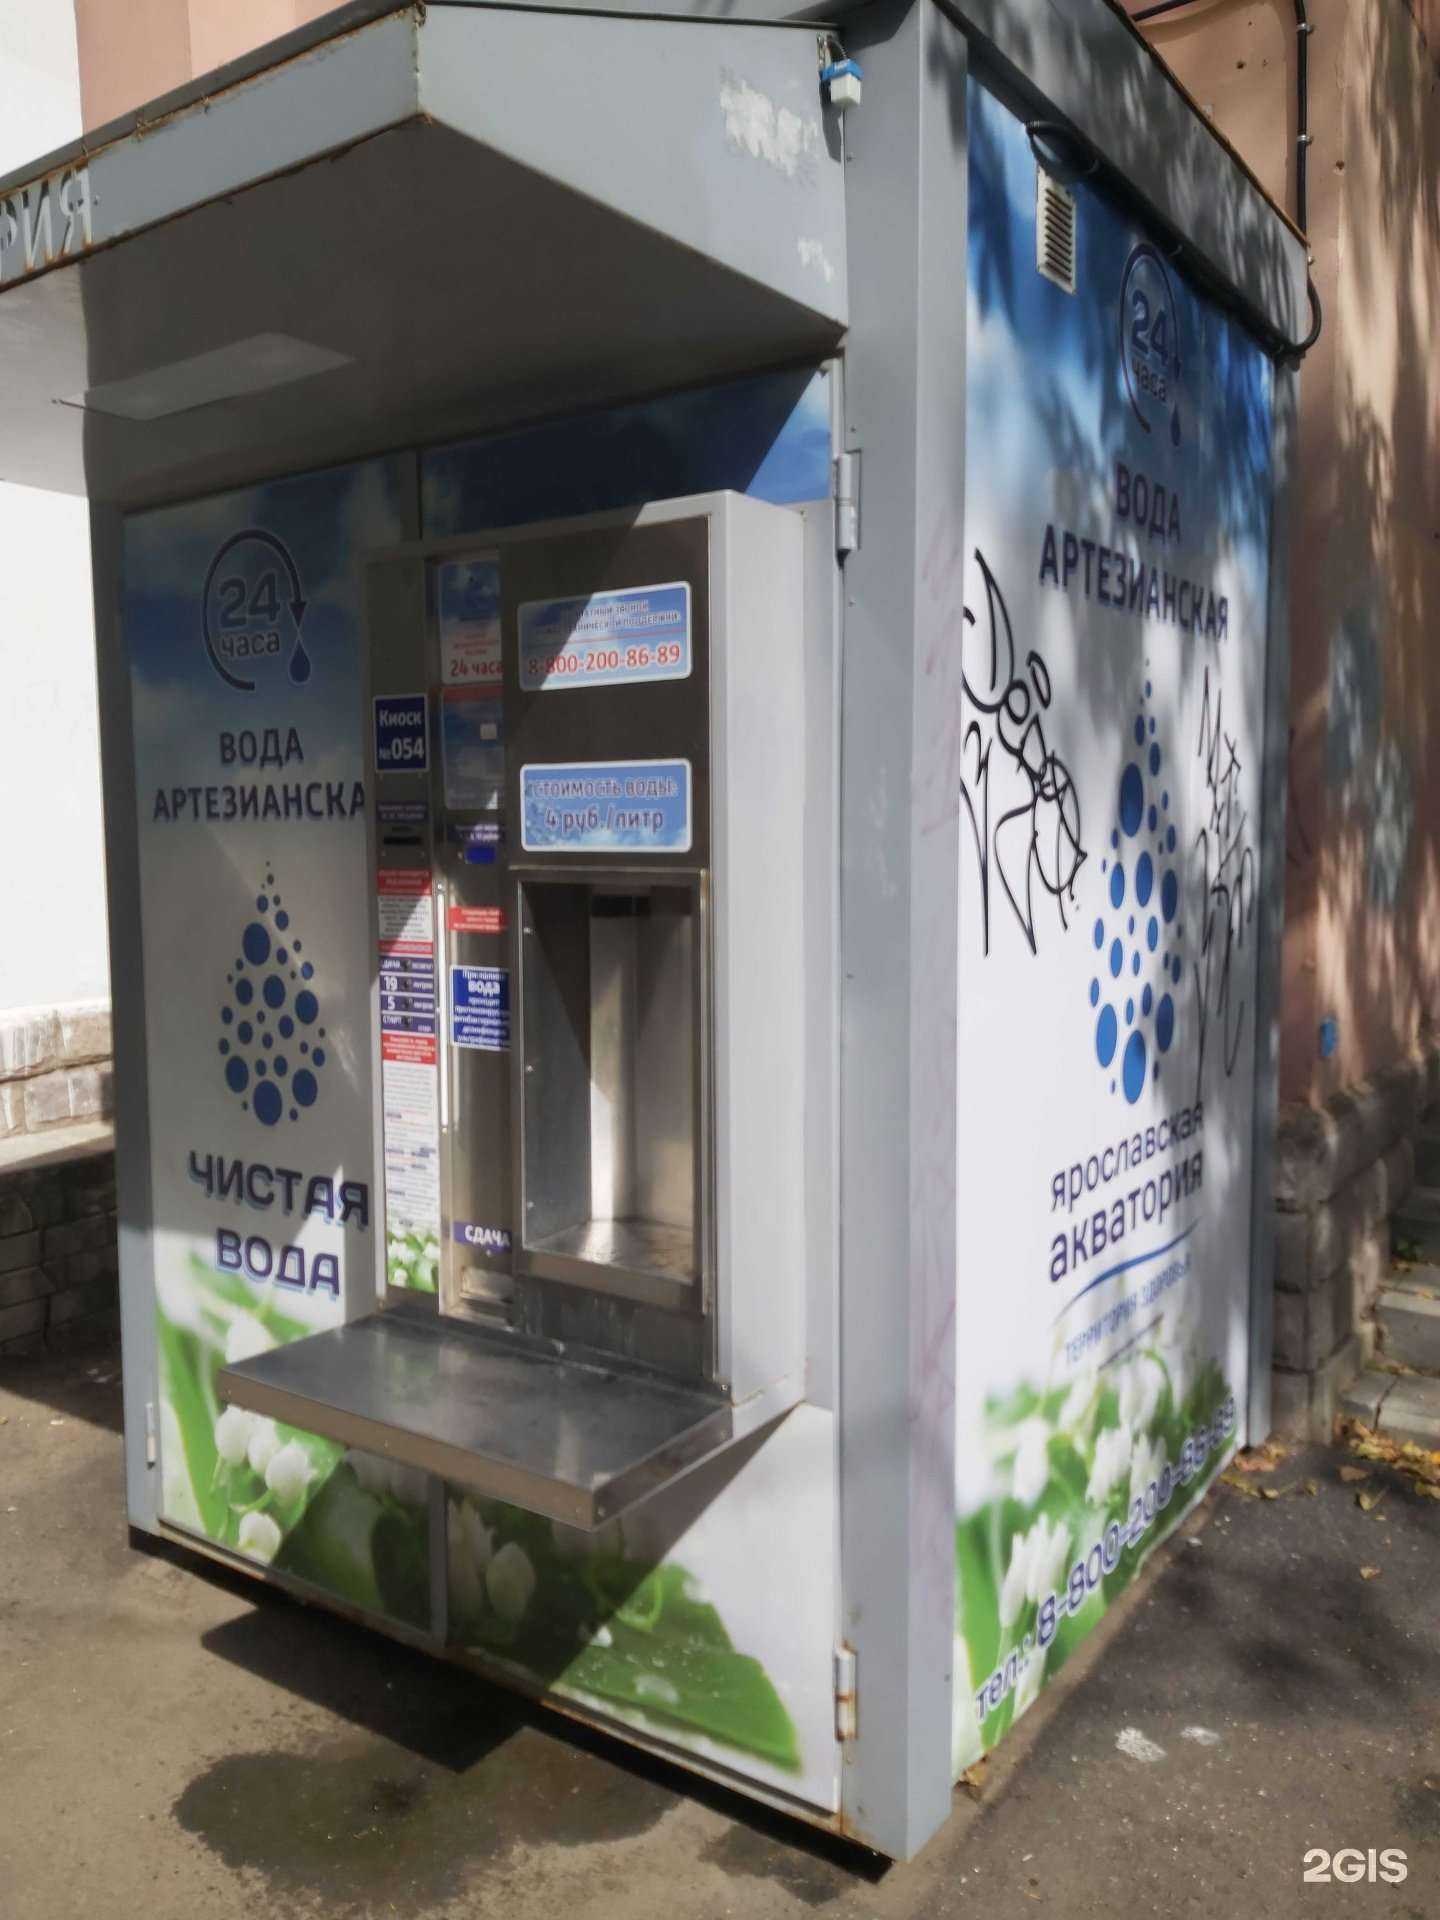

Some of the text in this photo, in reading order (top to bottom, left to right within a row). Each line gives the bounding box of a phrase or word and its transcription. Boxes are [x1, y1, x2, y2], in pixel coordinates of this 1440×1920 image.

[1132, 289, 1169, 367] 24
[1116, 461, 1182, 545] ВОДА
[218, 572, 281, 630] 24
[1039, 523, 1229, 641] АРТЕЗИАНСКАЯ
[220, 631, 281, 659] часа
[451, 657, 468, 677] 24
[528, 644, 681, 675] 8-800-200-86-89
[379, 709, 422, 727] Киоск
[218, 727, 304, 769] ВОДА
[545, 807, 557, 829] 4
[1051, 1101, 1205, 1213] ярославская
[190, 1151, 369, 1227] ЧИСТАЯ
[1050, 1149, 1204, 1284] акватория
[216, 1228, 341, 1296] ВОДА
[465, 1224, 510, 1247] СДАЧА
